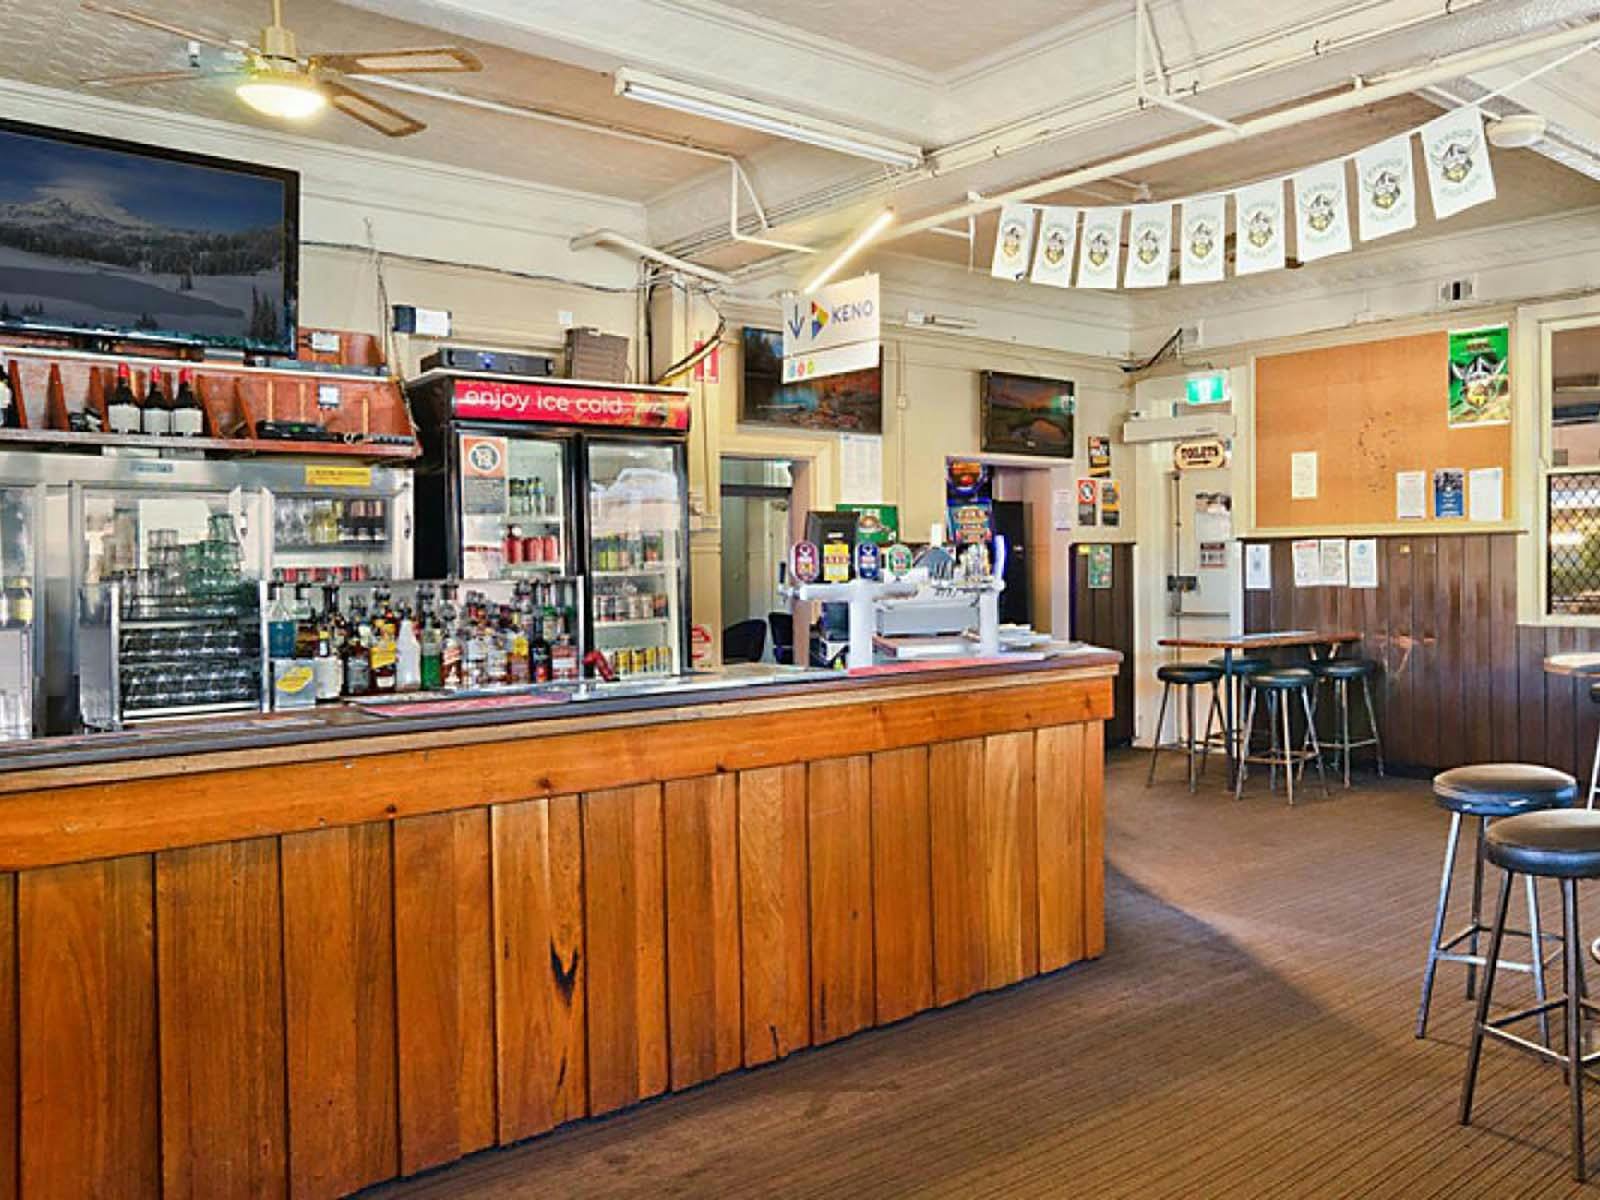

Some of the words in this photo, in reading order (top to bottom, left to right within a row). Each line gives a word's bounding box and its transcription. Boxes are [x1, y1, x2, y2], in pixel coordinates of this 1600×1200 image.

[831, 300, 873, 323] KENO
[463, 389, 529, 411] enjoy
[537, 390, 569, 411] ice
[575, 396, 623, 415] cold
[1181, 447, 1218, 458] TOILETS
